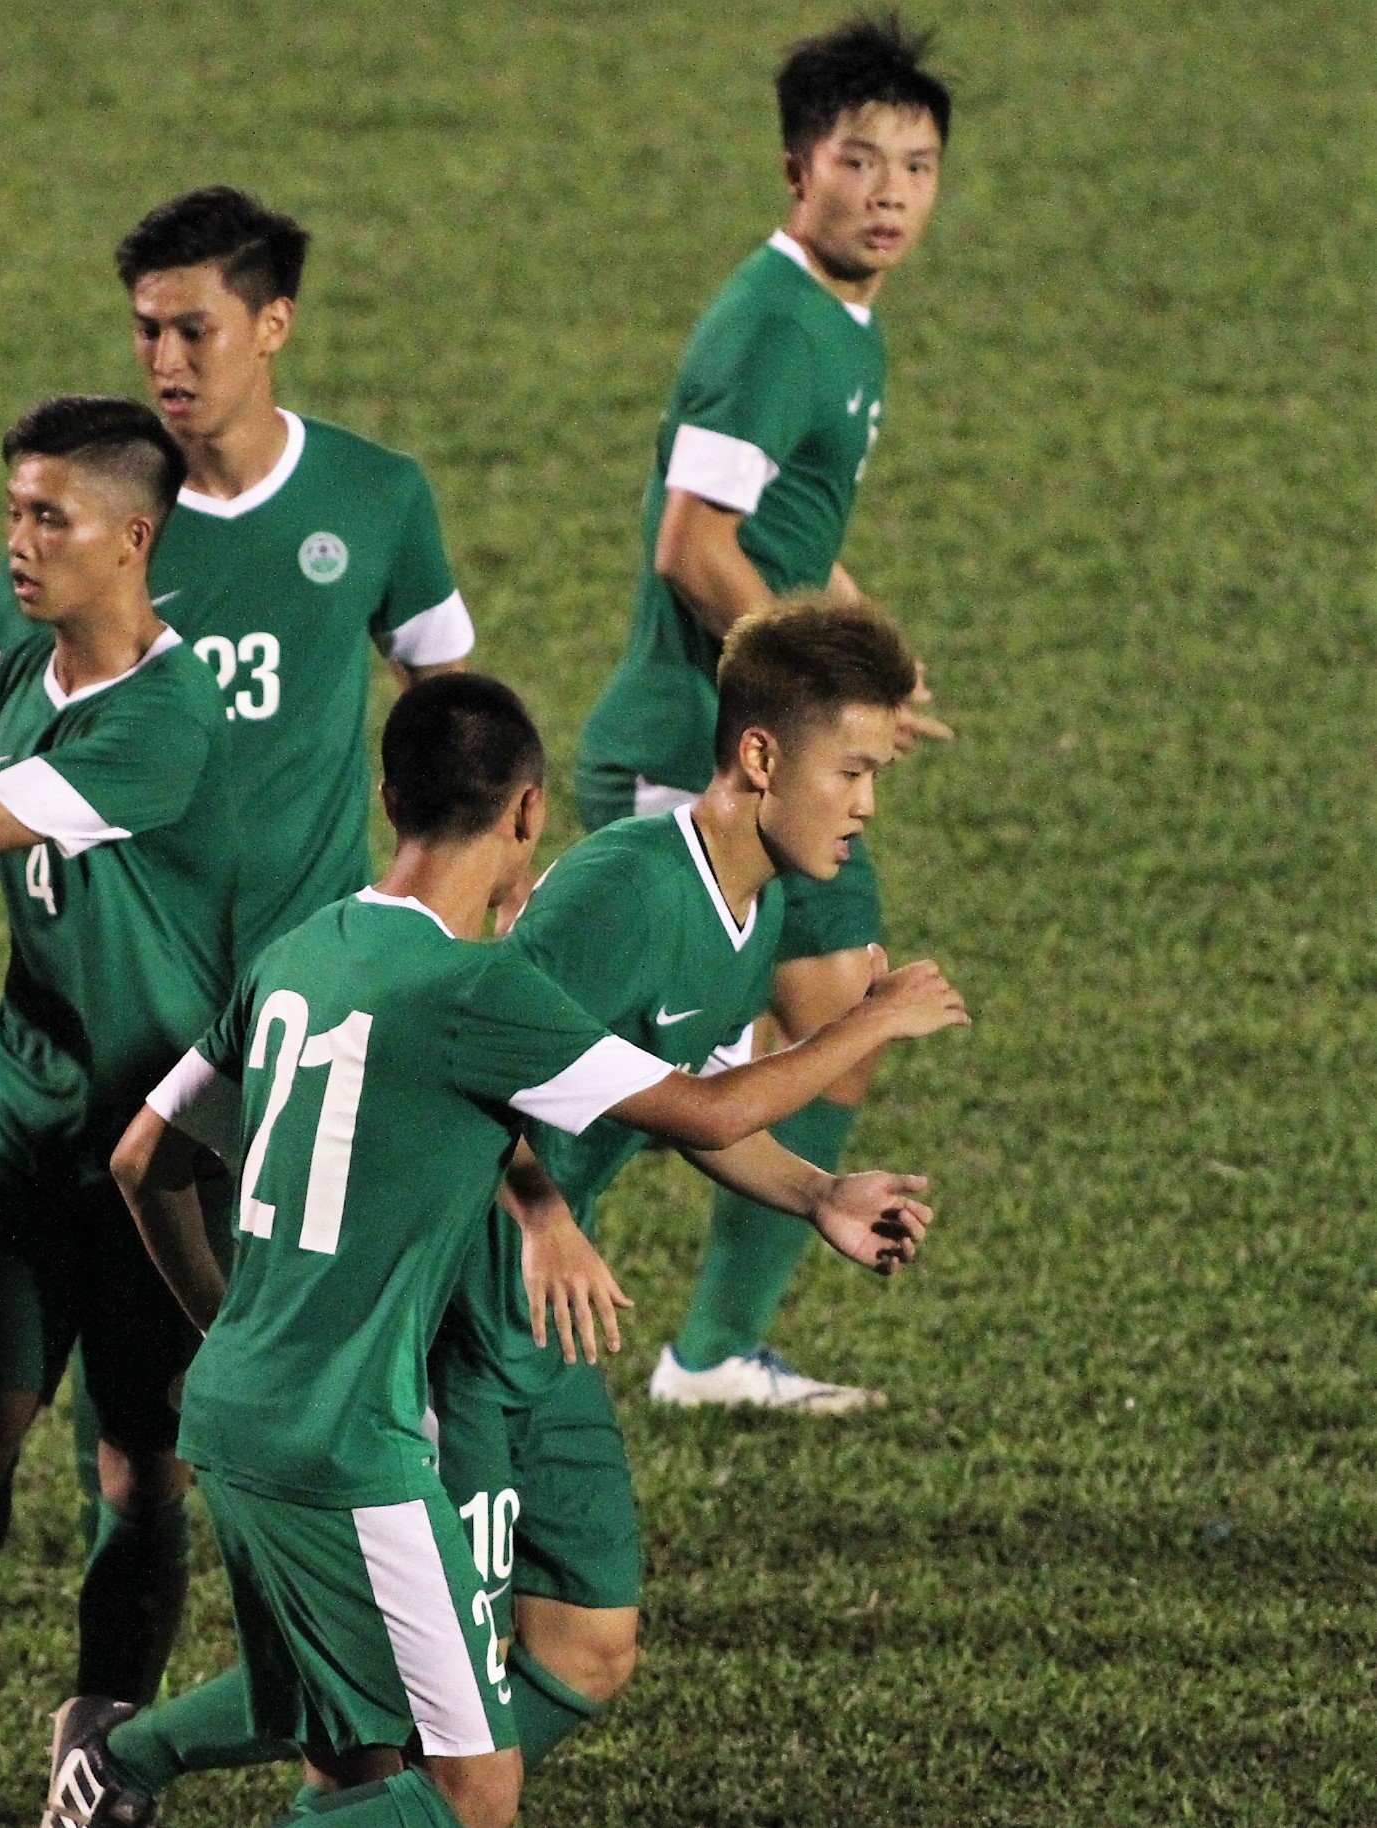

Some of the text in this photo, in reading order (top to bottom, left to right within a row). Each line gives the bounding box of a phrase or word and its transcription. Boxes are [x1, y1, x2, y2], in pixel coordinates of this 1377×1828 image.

[192, 631, 281, 721] 23
[25, 842, 58, 916] 4
[239, 989, 374, 1256] 21
[459, 1487, 521, 1583] 10
